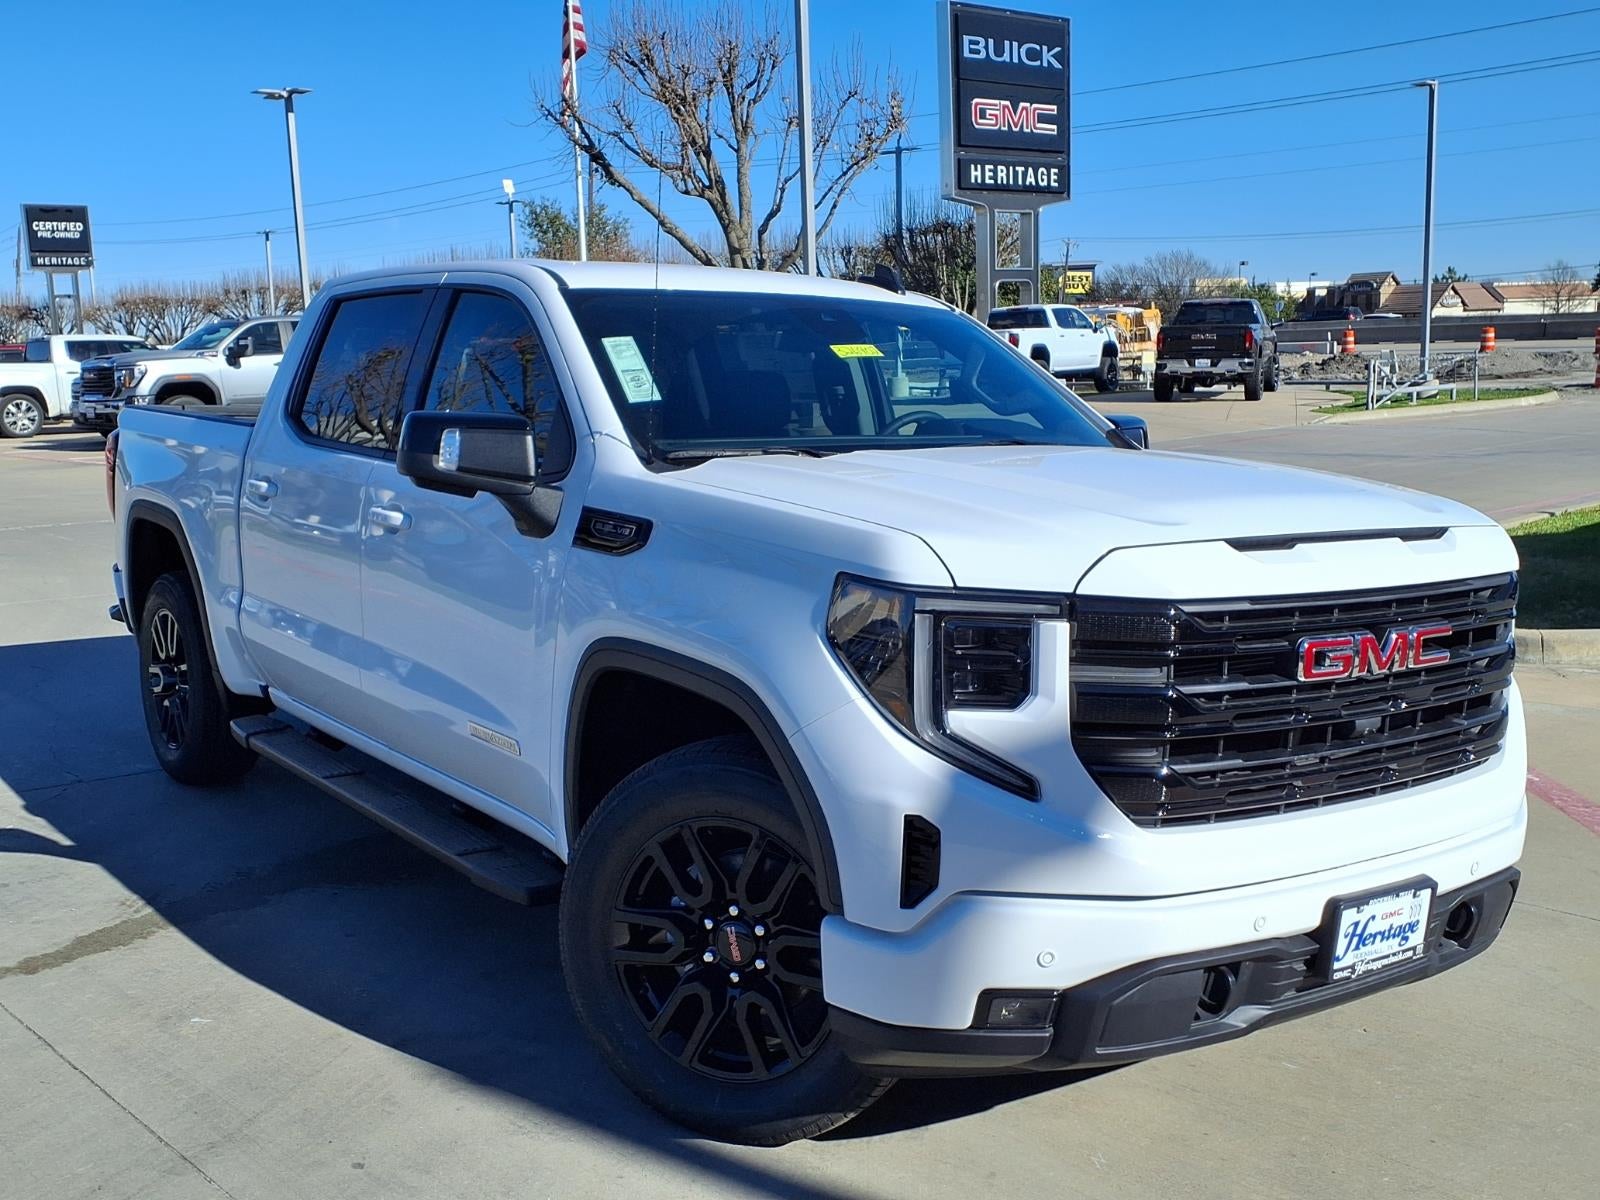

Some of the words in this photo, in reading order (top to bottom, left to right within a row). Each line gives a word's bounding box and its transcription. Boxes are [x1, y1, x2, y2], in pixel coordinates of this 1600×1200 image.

[962, 34, 1063, 69] BUICK
[971, 97, 1058, 135] GMC
[970, 163, 1059, 187] HERITAGE
[32, 221, 84, 231] CERTIFIED
[37, 256, 87, 265] HERITAGE
[1296, 622, 1454, 682] GMC
[1381, 907, 1404, 920] GMC
[727, 926, 741, 961] GMC
[1332, 914, 1419, 962] Heritage
[1333, 969, 1352, 979] GMC
